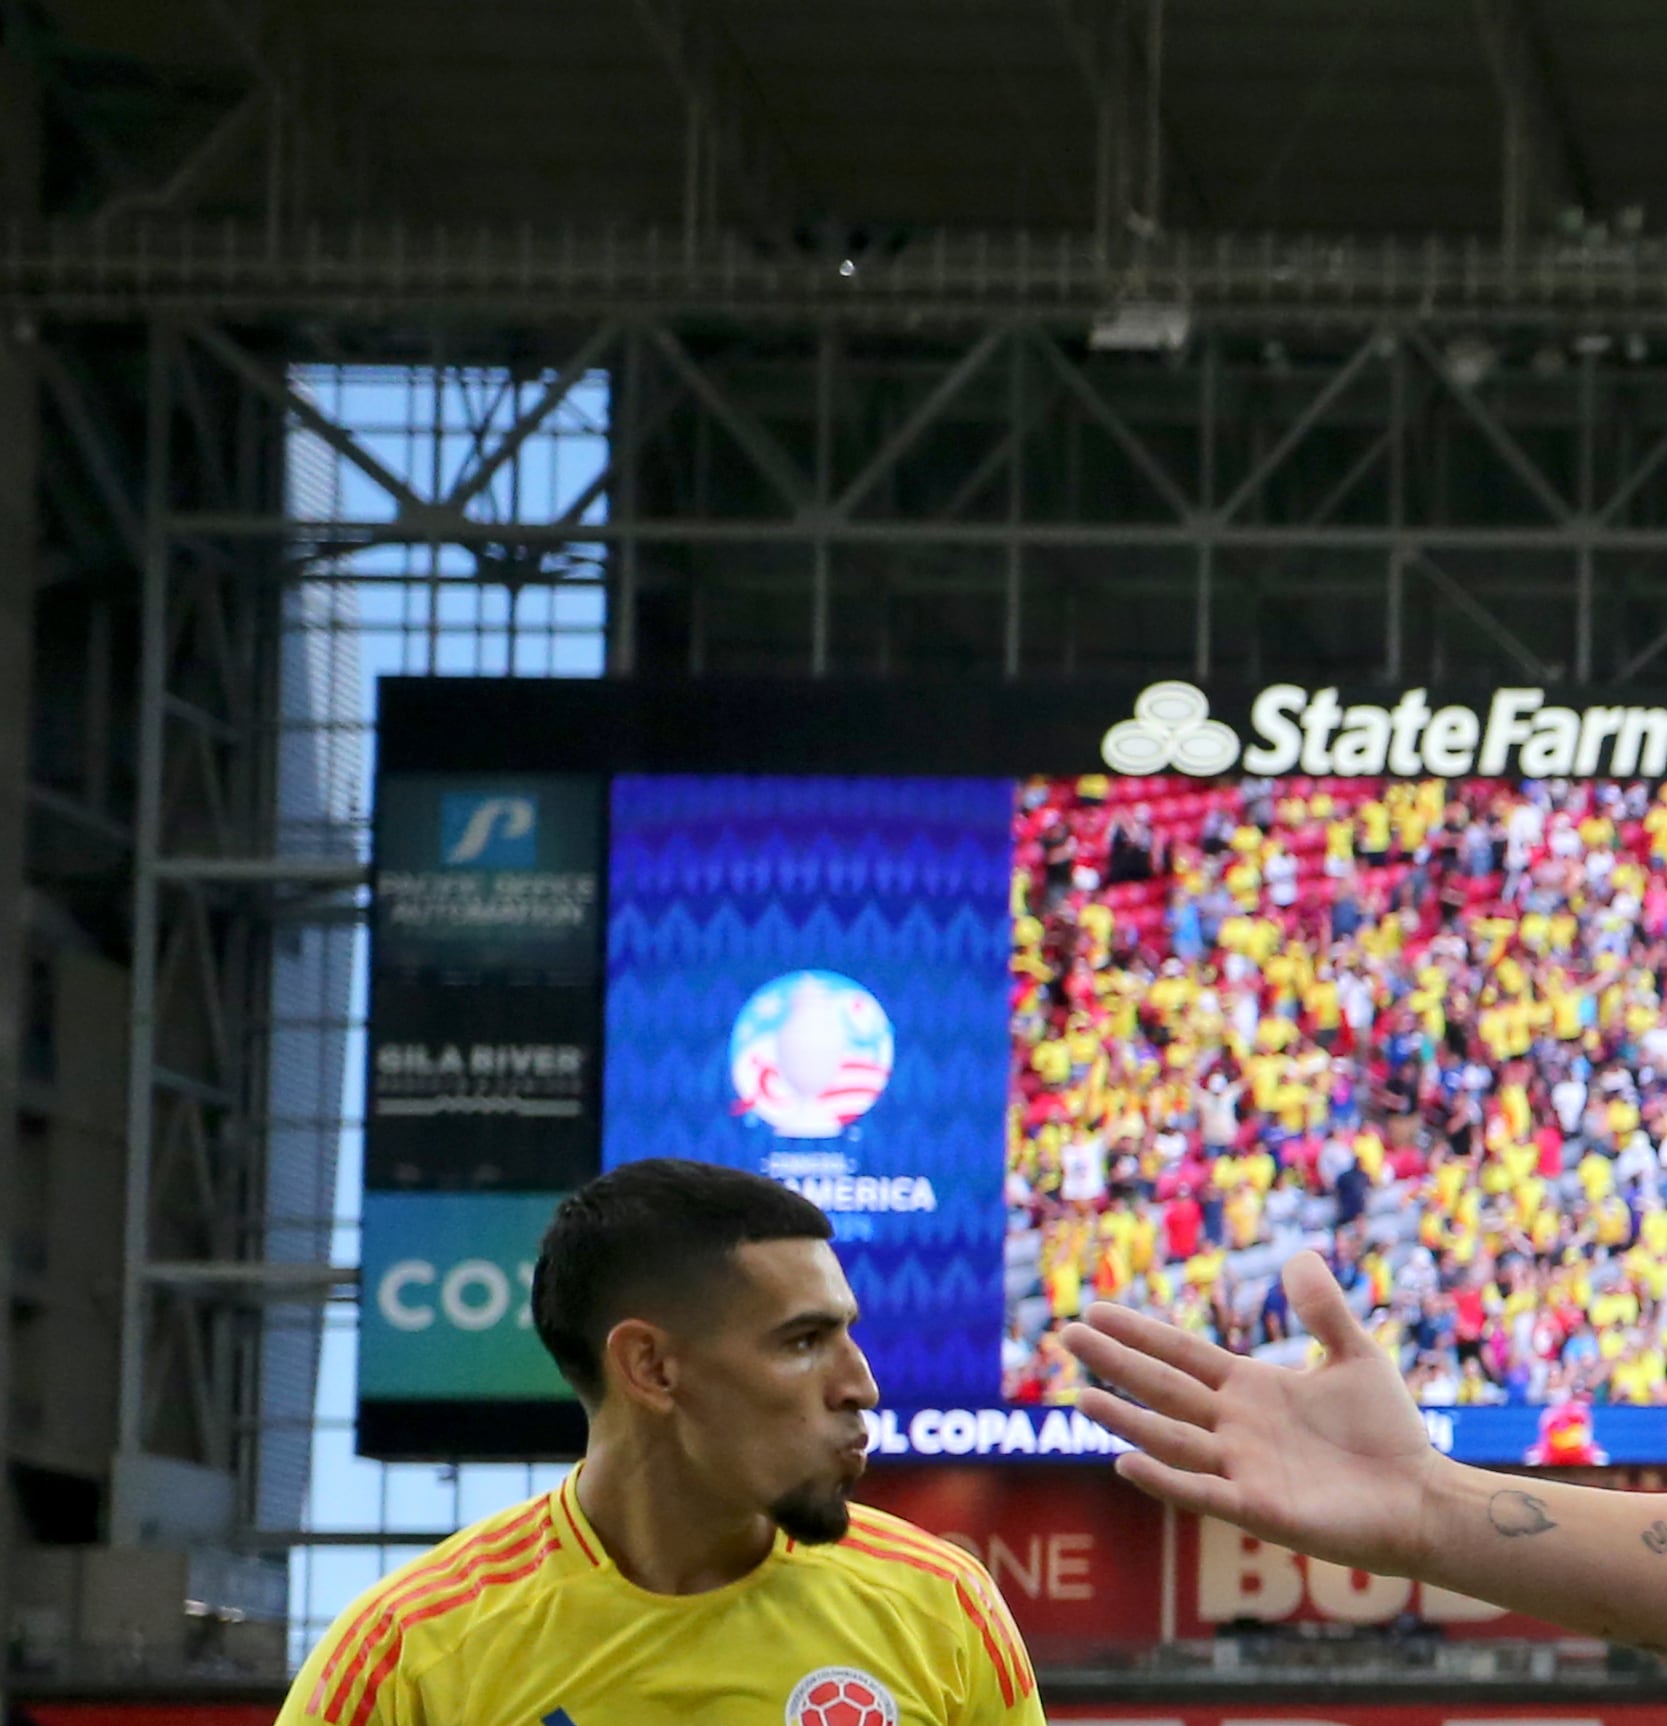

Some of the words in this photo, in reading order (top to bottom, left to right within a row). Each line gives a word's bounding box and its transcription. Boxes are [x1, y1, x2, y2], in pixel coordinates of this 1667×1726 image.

[377, 1043, 464, 1075] GILA
[470, 1043, 582, 1077] RIVER
[909, 1408, 1038, 1455] COPA
